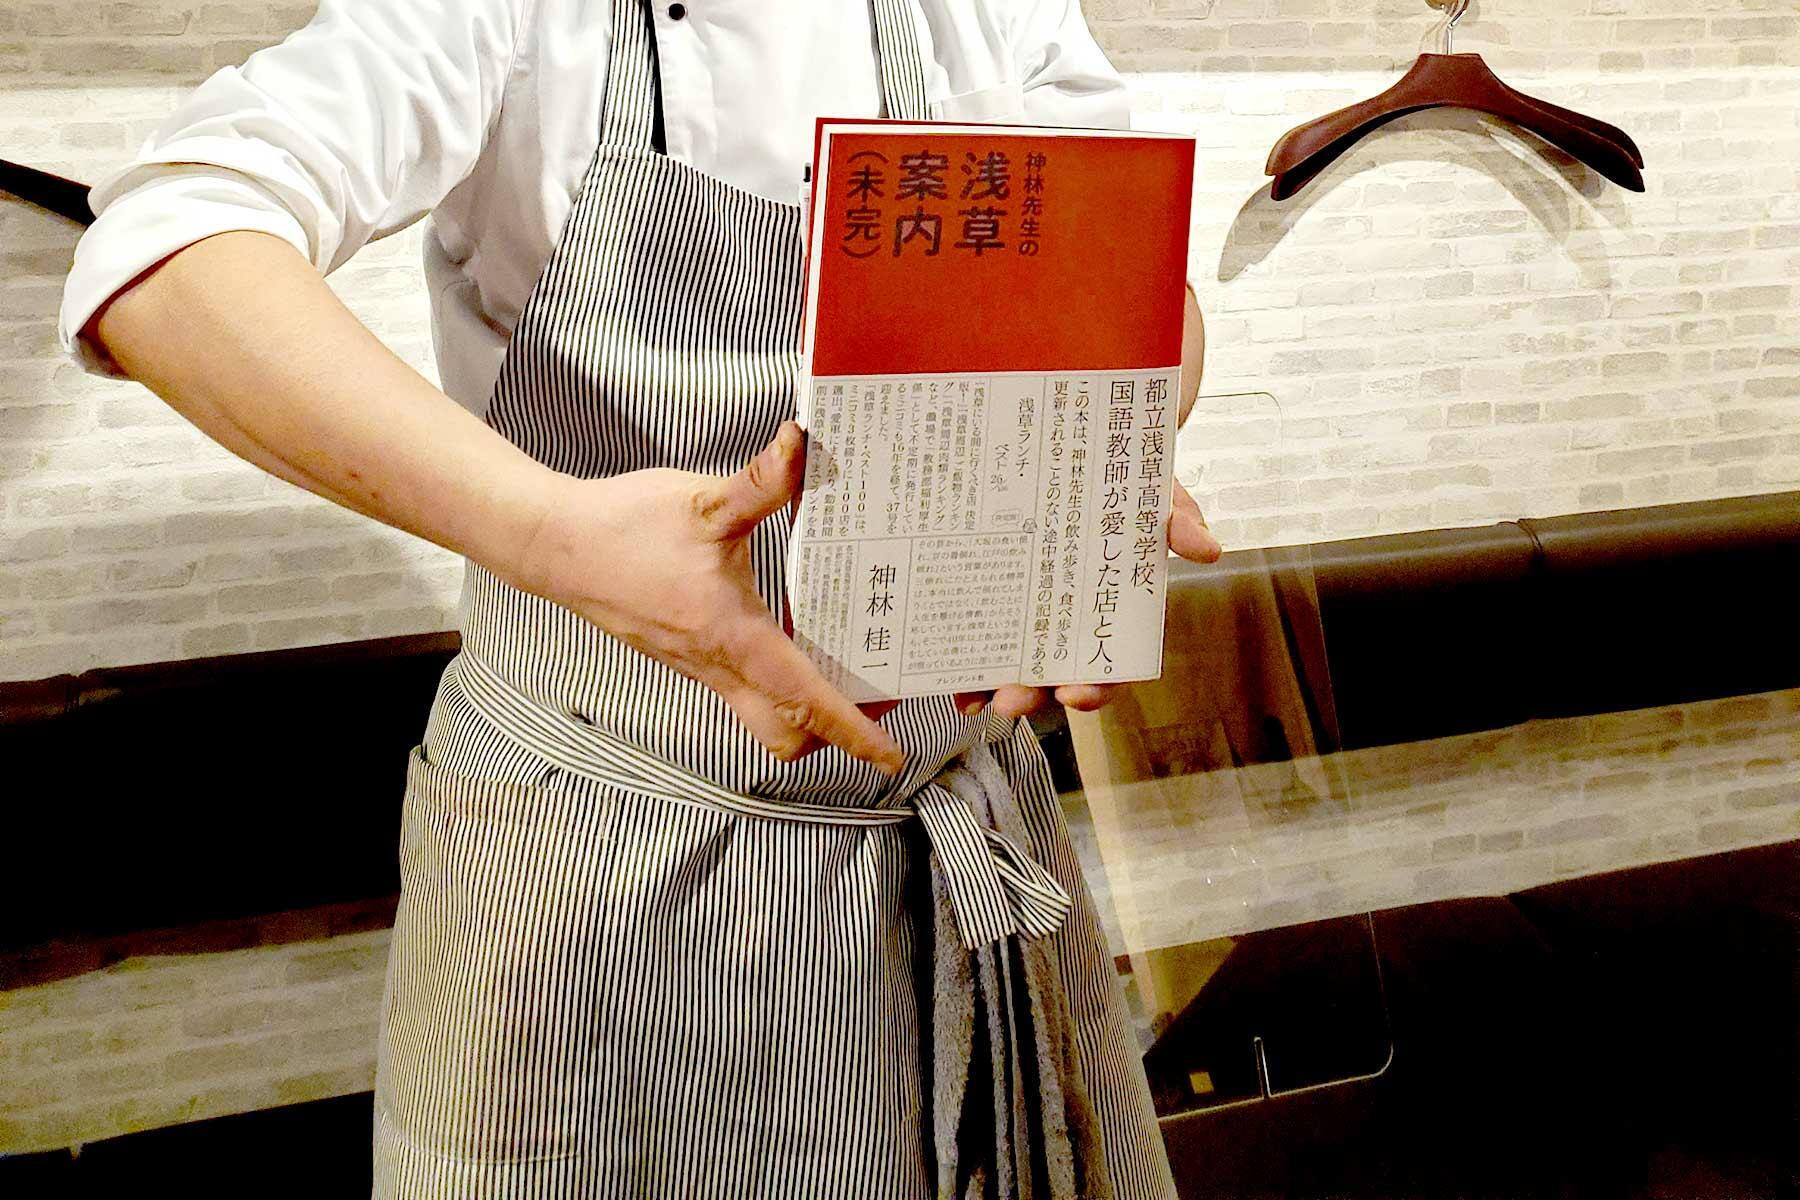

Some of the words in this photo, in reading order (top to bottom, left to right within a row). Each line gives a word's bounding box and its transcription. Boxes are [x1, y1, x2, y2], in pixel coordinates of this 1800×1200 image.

[892, 149, 949, 257] 案内
[953, 150, 1012, 257] 浅草
[1018, 151, 1047, 257] 神林先生の
[1087, 380, 1135, 675] 国語教師が愛した店と人。
[1129, 377, 1169, 597] 都立浅草高等学校、
[865, 562, 897, 617] 神林
[861, 625, 892, 670] 桂一
